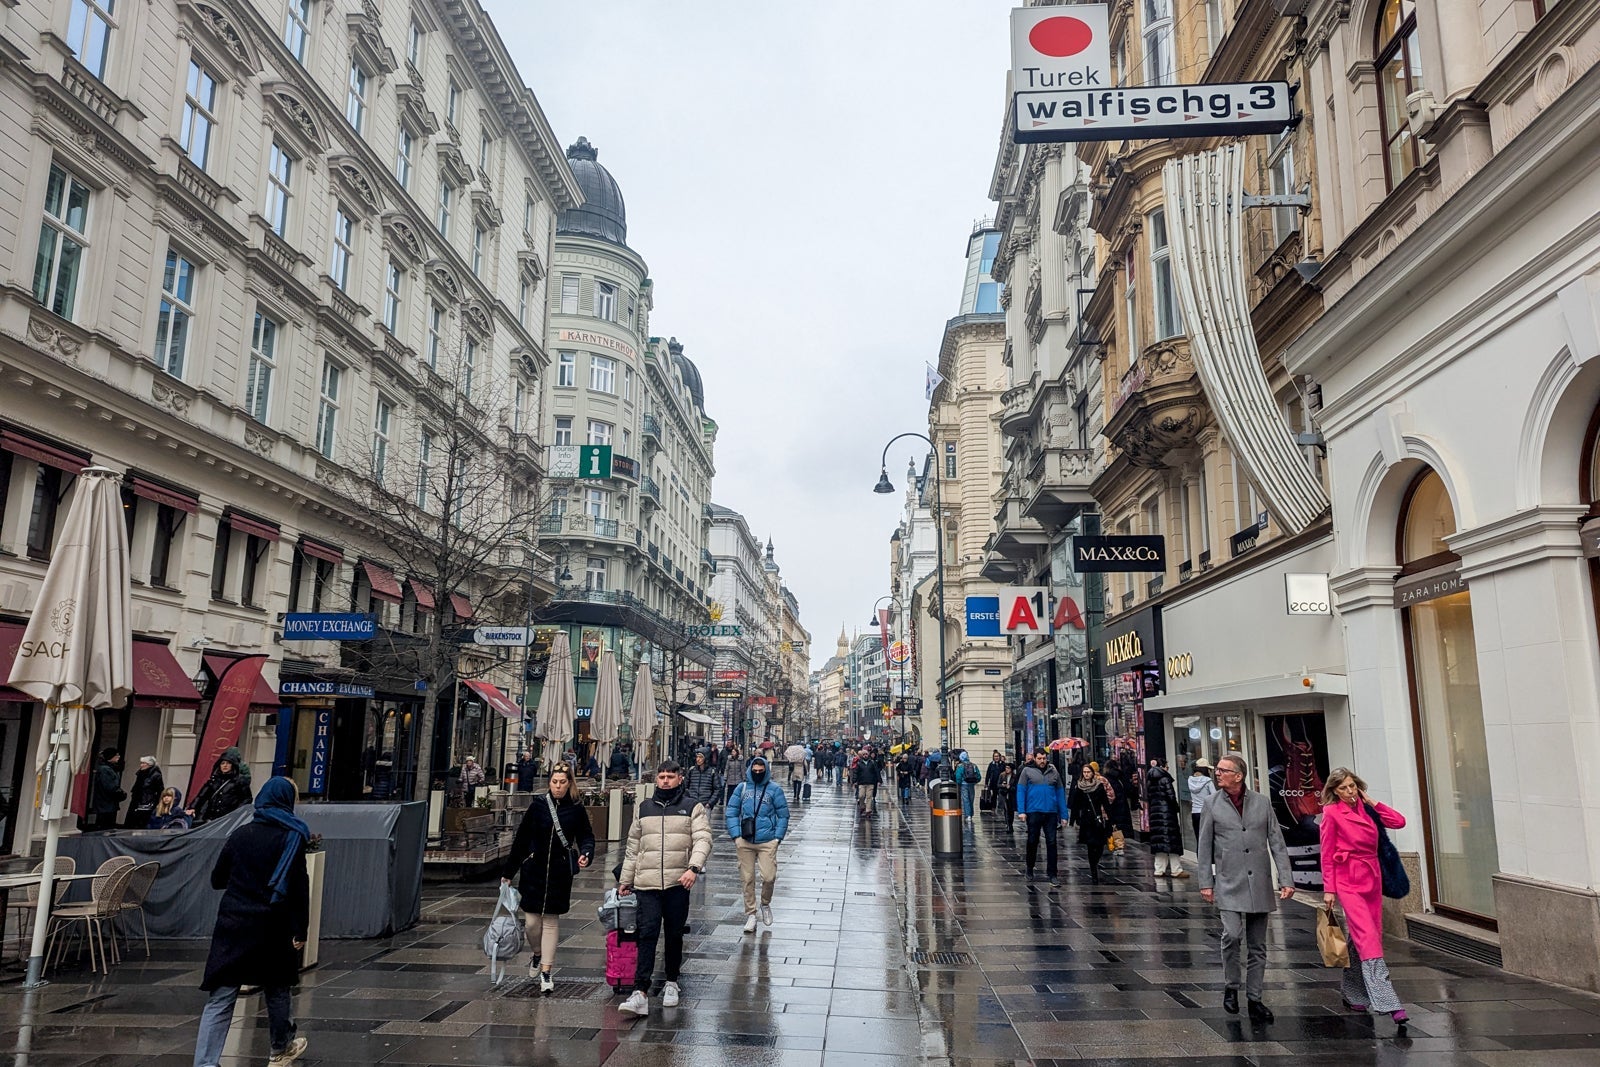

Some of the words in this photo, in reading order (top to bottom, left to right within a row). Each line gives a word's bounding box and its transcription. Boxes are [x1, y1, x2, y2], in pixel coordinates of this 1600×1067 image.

[1023, 66, 1101, 87] Turek
[1027, 85, 1276, 119] walfischg.3
[567, 331, 634, 357] KÄRNTNERHOF
[1079, 546, 1160, 561] MAX&Co.
[1402, 586, 1429, 602] ZARA
[1433, 578, 1465, 593] HOME
[970, 612, 994, 620] ERSTE
[1006, 591, 1044, 630] A1
[1290, 602, 1328, 612] ecco
[286, 620, 321, 632] MONEY
[322, 620, 374, 632] EXCHANGE
[485, 632, 522, 640] BIRKENSTOCK
[688, 625, 743, 636] ROLEX
[1106, 630, 1142, 666] MAX&Co.
[1168, 651, 1192, 680] ecco
[282, 682, 334, 693] CHANGE
[339, 683, 373, 696] EXCHANGE
[312, 712, 328, 789] CHANGE
